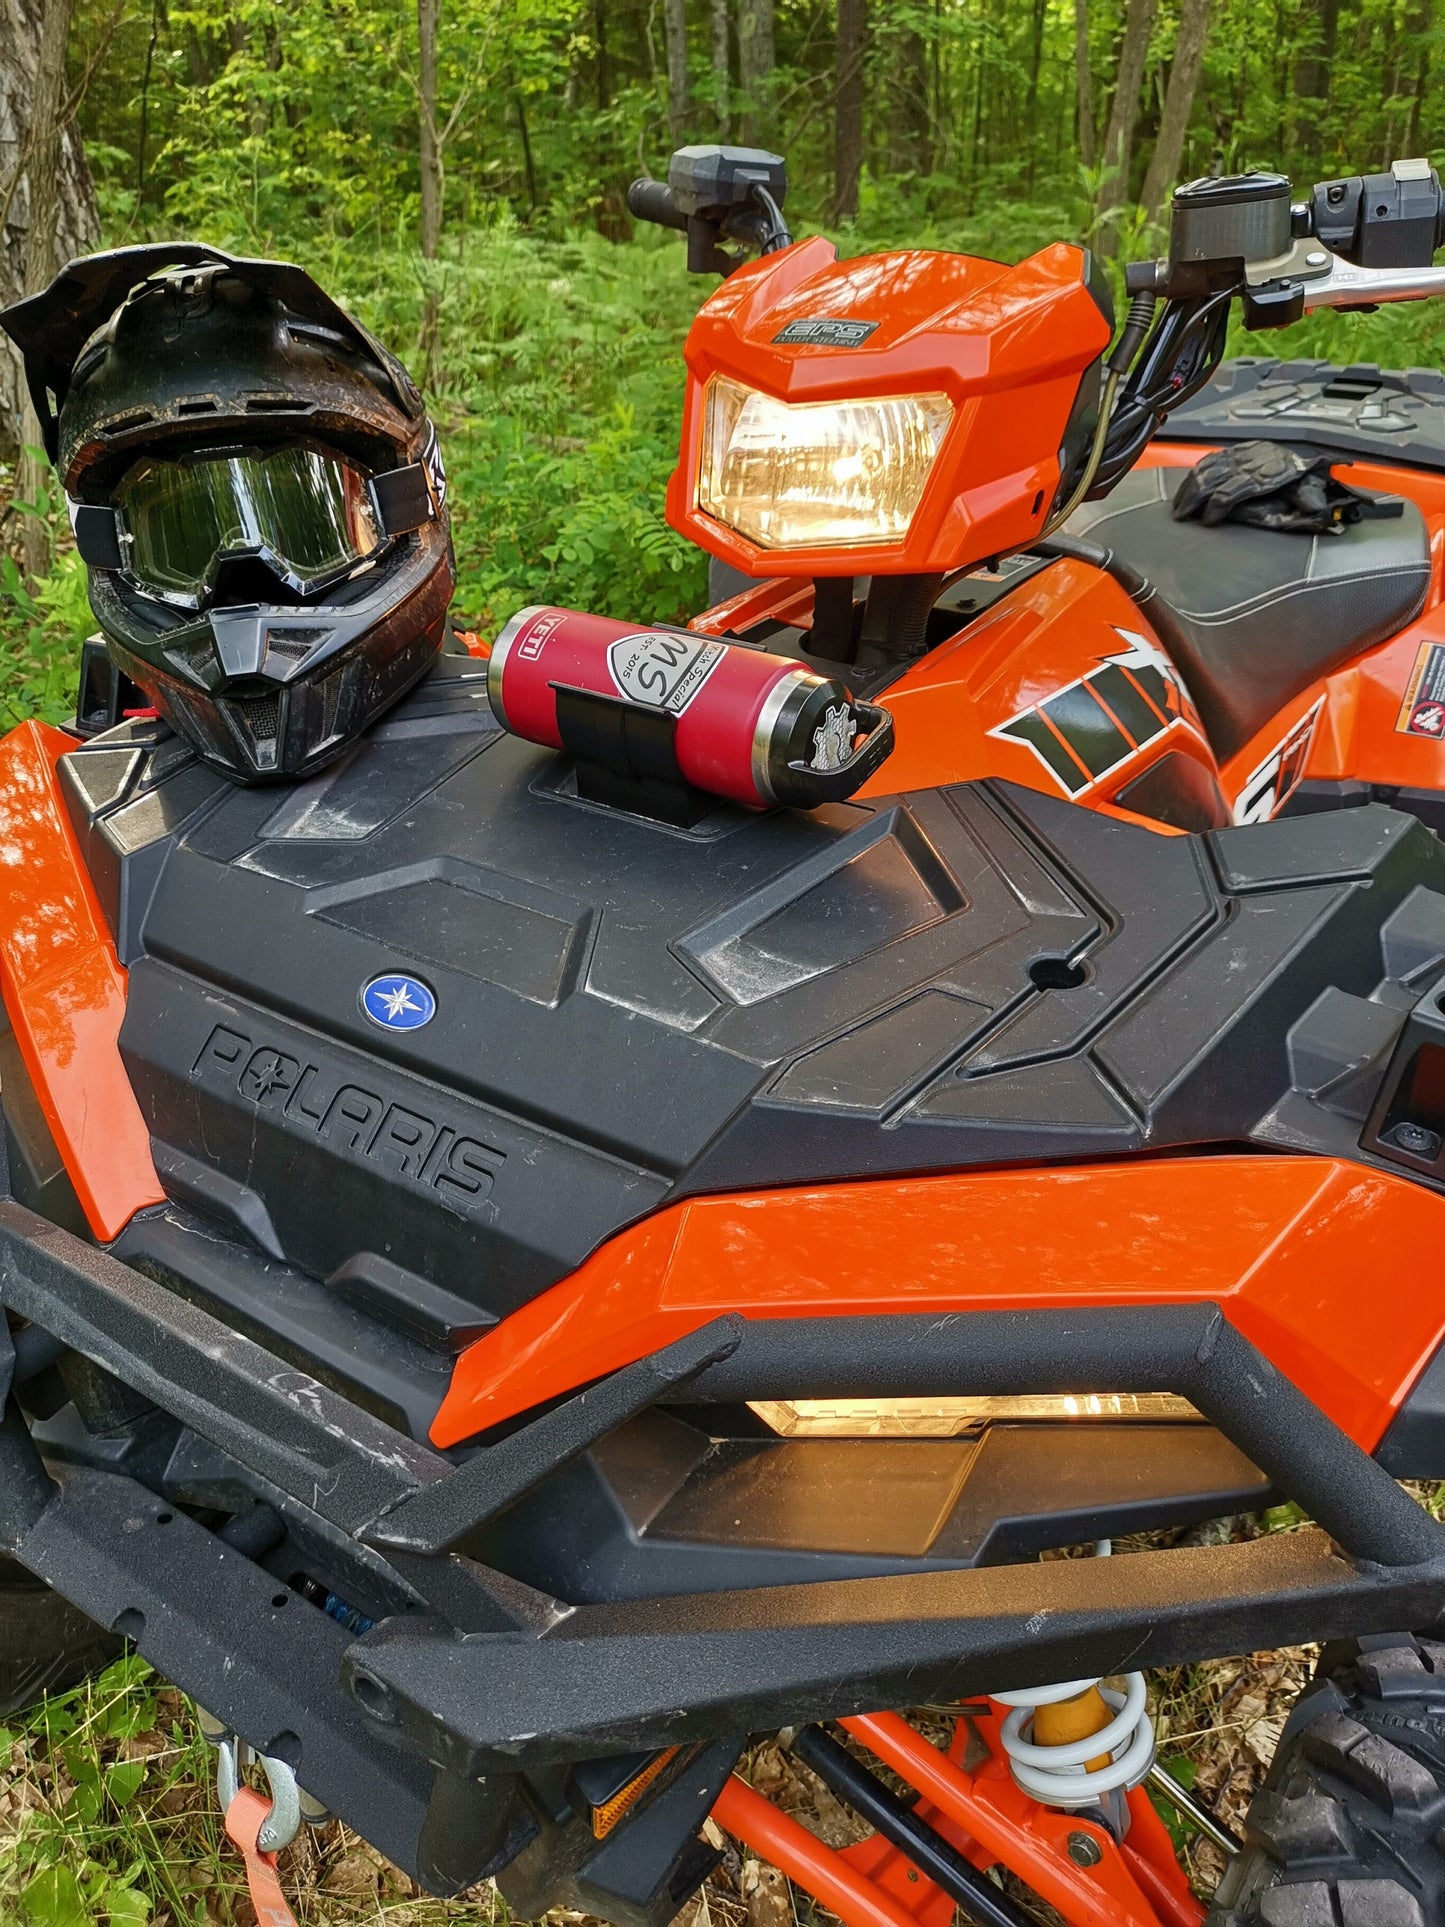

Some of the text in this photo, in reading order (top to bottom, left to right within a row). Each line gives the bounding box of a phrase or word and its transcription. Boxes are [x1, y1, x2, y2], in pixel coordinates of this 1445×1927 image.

[784, 322, 871, 340] EPS
[523, 617, 562, 655] YETI
[622, 653, 641, 680] 2015
[671, 666, 704, 709] Special
[188, 1022, 508, 1206] POLARIS
